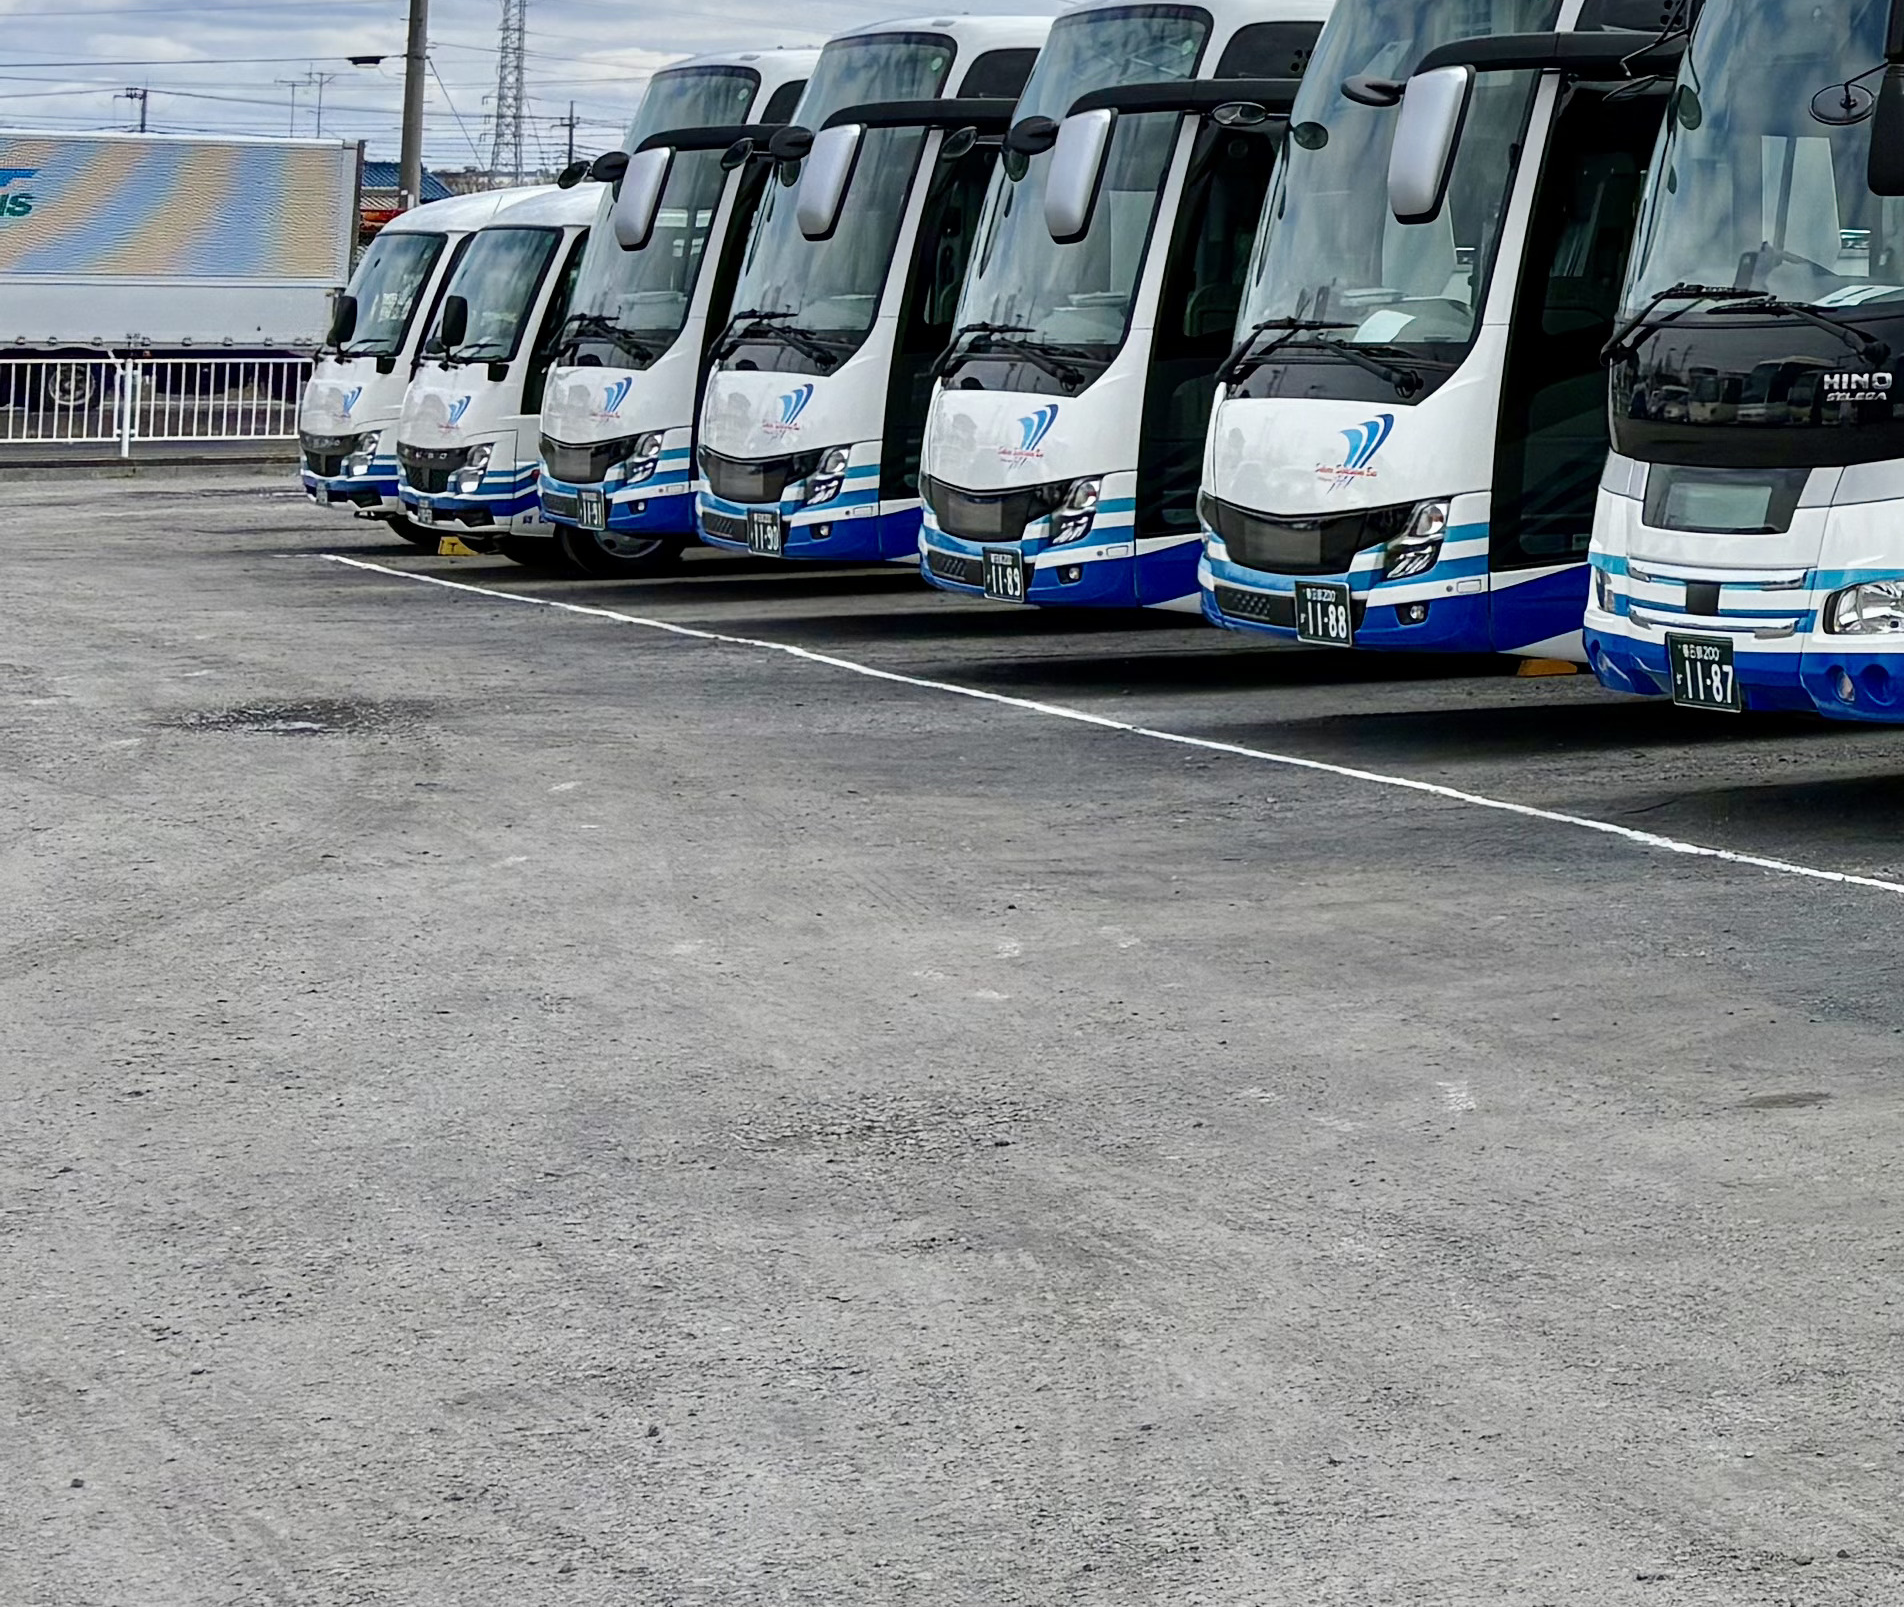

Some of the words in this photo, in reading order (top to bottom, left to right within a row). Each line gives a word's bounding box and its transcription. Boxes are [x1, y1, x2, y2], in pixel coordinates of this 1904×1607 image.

[1823, 372, 1893, 390] HINO
[992, 564, 1021, 597] 11-89
[1307, 601, 1347, 639] 11-88
[1685, 659, 1734, 704] 11-87
